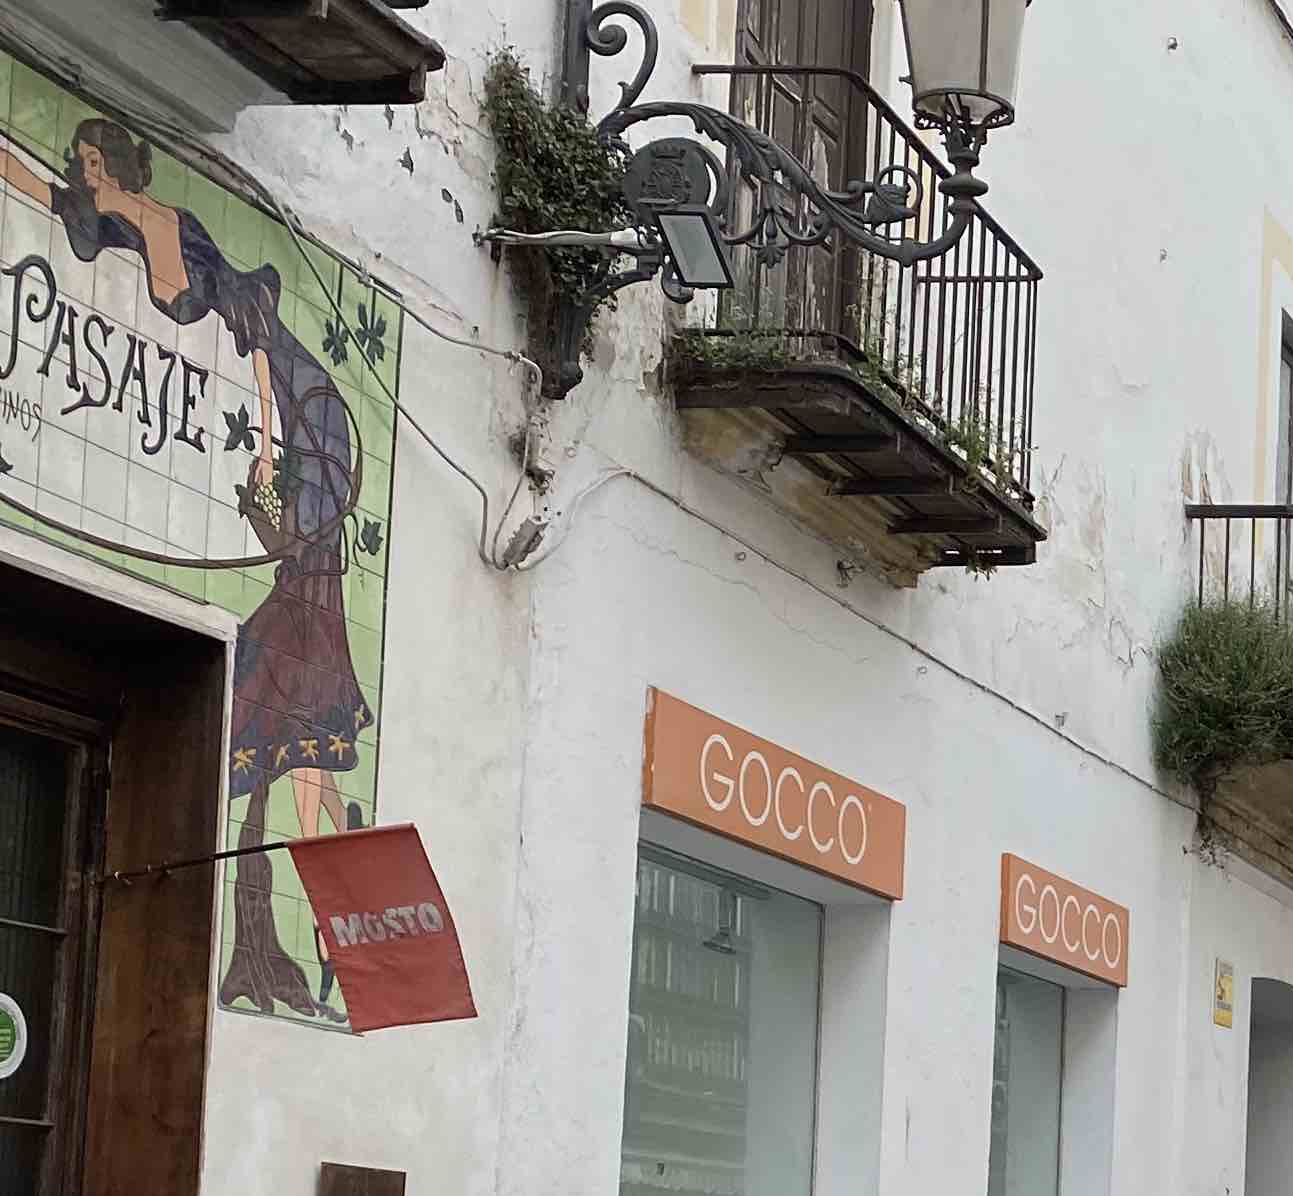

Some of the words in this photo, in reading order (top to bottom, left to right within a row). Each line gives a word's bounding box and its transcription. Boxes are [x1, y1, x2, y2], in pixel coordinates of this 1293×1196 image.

[0, 254, 209, 455] PASAJE
[0, 387, 42, 442] INOS
[700, 733, 868, 866] GOCCO
[328, 901, 445, 948] MOSTO
[1015, 873, 1122, 969] GOCCO
